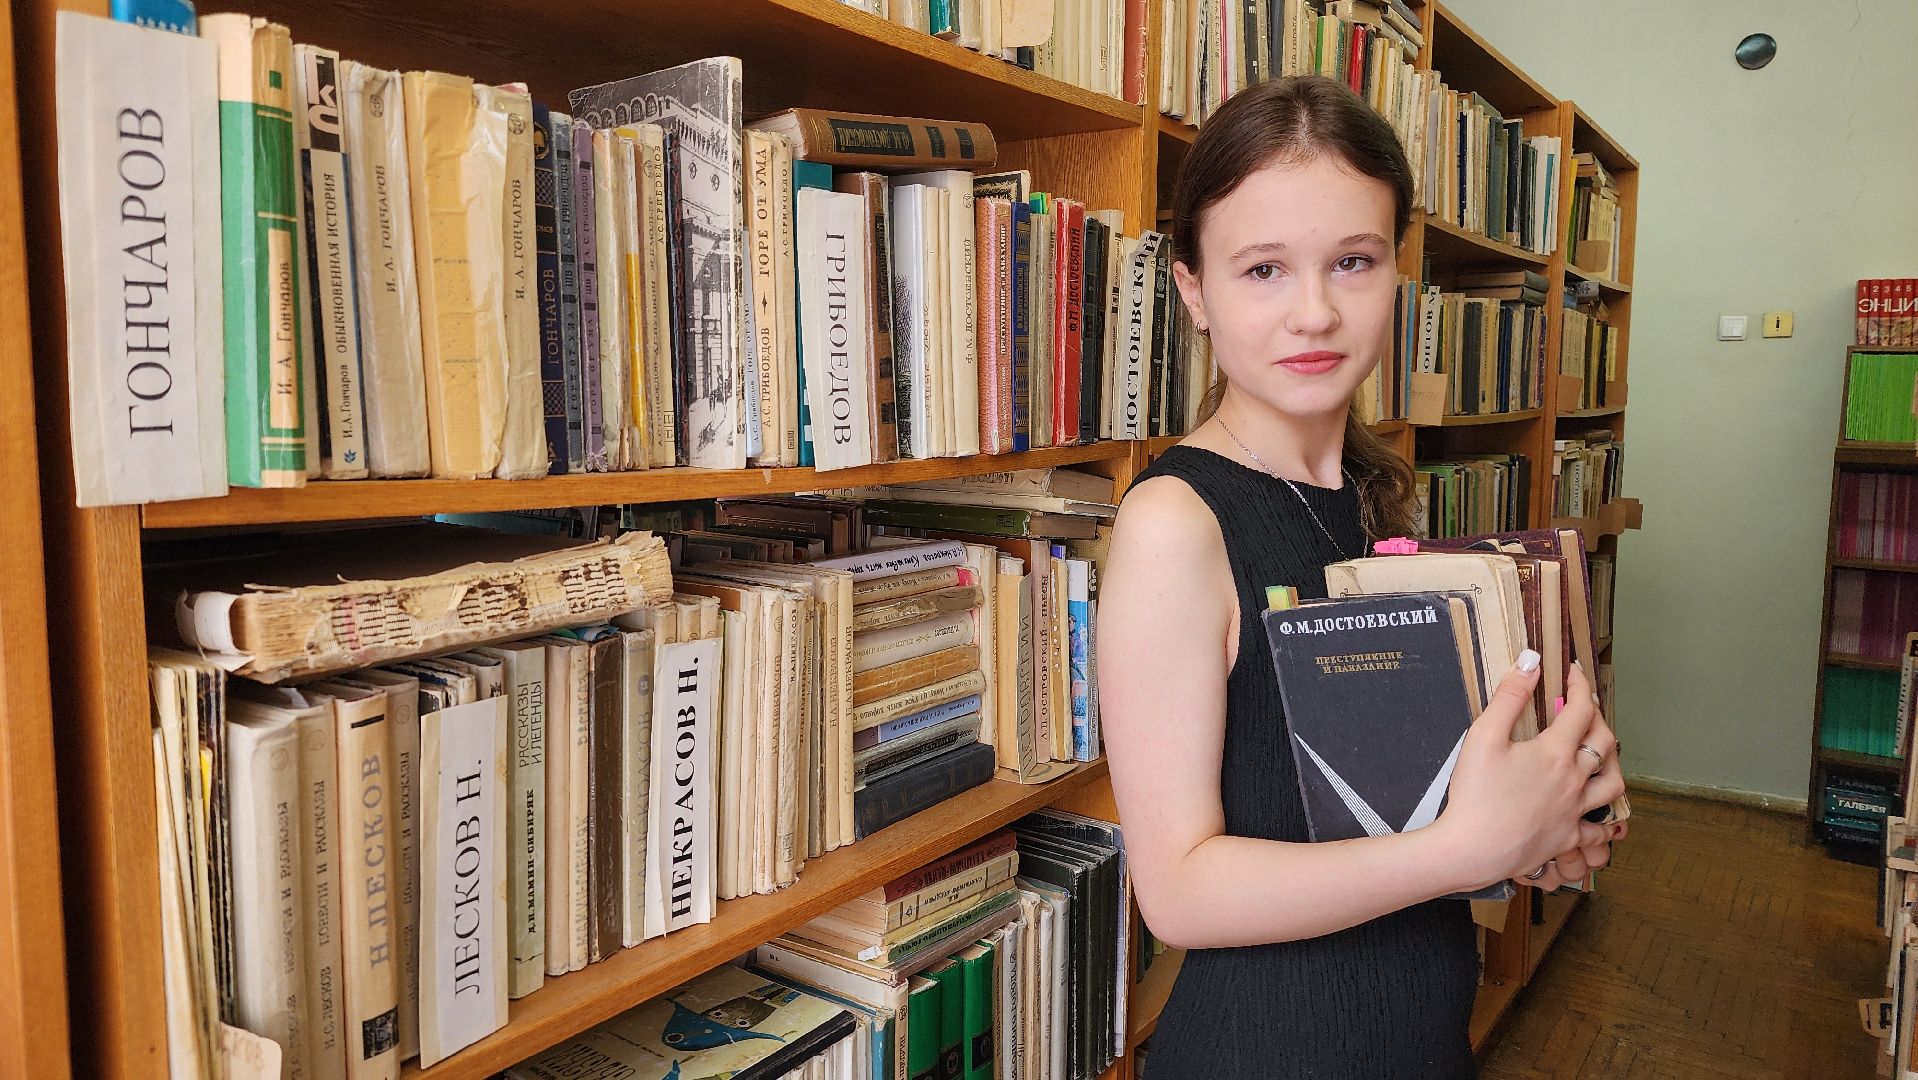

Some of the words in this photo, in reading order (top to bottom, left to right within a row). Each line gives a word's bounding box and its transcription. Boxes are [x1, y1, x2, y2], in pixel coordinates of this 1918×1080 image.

[755, 148, 768, 187] УМА
[323, 173, 339, 238] ИСТОРИЯ
[374, 165, 392, 249] ГОНЧАРОВ
[512, 179, 523, 258] ГОНЧАРОВ
[756, 196, 768, 220] ОТ
[116, 107, 173, 438] ГОНЧАРОВ
[386, 277, 397, 293] И.
[758, 230, 770, 278] ГОРЕ
[962, 238, 974, 334] ДОСТОЕВСКИЙ
[276, 262, 293, 342] Гончаров
[327, 241, 348, 353] ОБЫКНОВЕННАЯ
[516, 286, 525, 299] И.
[542, 268, 560, 364] ГОНЧАРОВ
[276, 351, 292, 369] А.
[760, 327, 772, 402] ГРИБОЕДОВ
[826, 230, 852, 444] ГРИБОЕДОВ
[1124, 233, 1159, 440] ДОСТОЕВСКИЙ
[277, 378, 293, 395] И.
[1040, 574, 1048, 618] ПЬЕСЫ
[1278, 605, 1438, 636] Ф.М.ДОСТОЕВСКИЙ
[677, 656, 699, 696] Н.
[1038, 628, 1048, 716] ОСТРОВСКИЙ
[1314, 649, 1403, 666] ПРЕСТУПЛЕНИЕ
[1333, 660, 1400, 674] НАКАЗАНИЕ
[518, 684, 530, 768] РАССКАЗЫ
[530, 681, 543, 750] ЛЕГЕНДЫ
[456, 760, 482, 806] Н.
[531, 754, 542, 766] И
[671, 706, 696, 920] НЕКРАСОВ
[1838, 799, 1886, 814] ГАЛЕРЕЯ
[360, 753, 393, 970] Н.ЛЕСКОВ
[454, 816, 482, 996] ЛЕСКОВ
